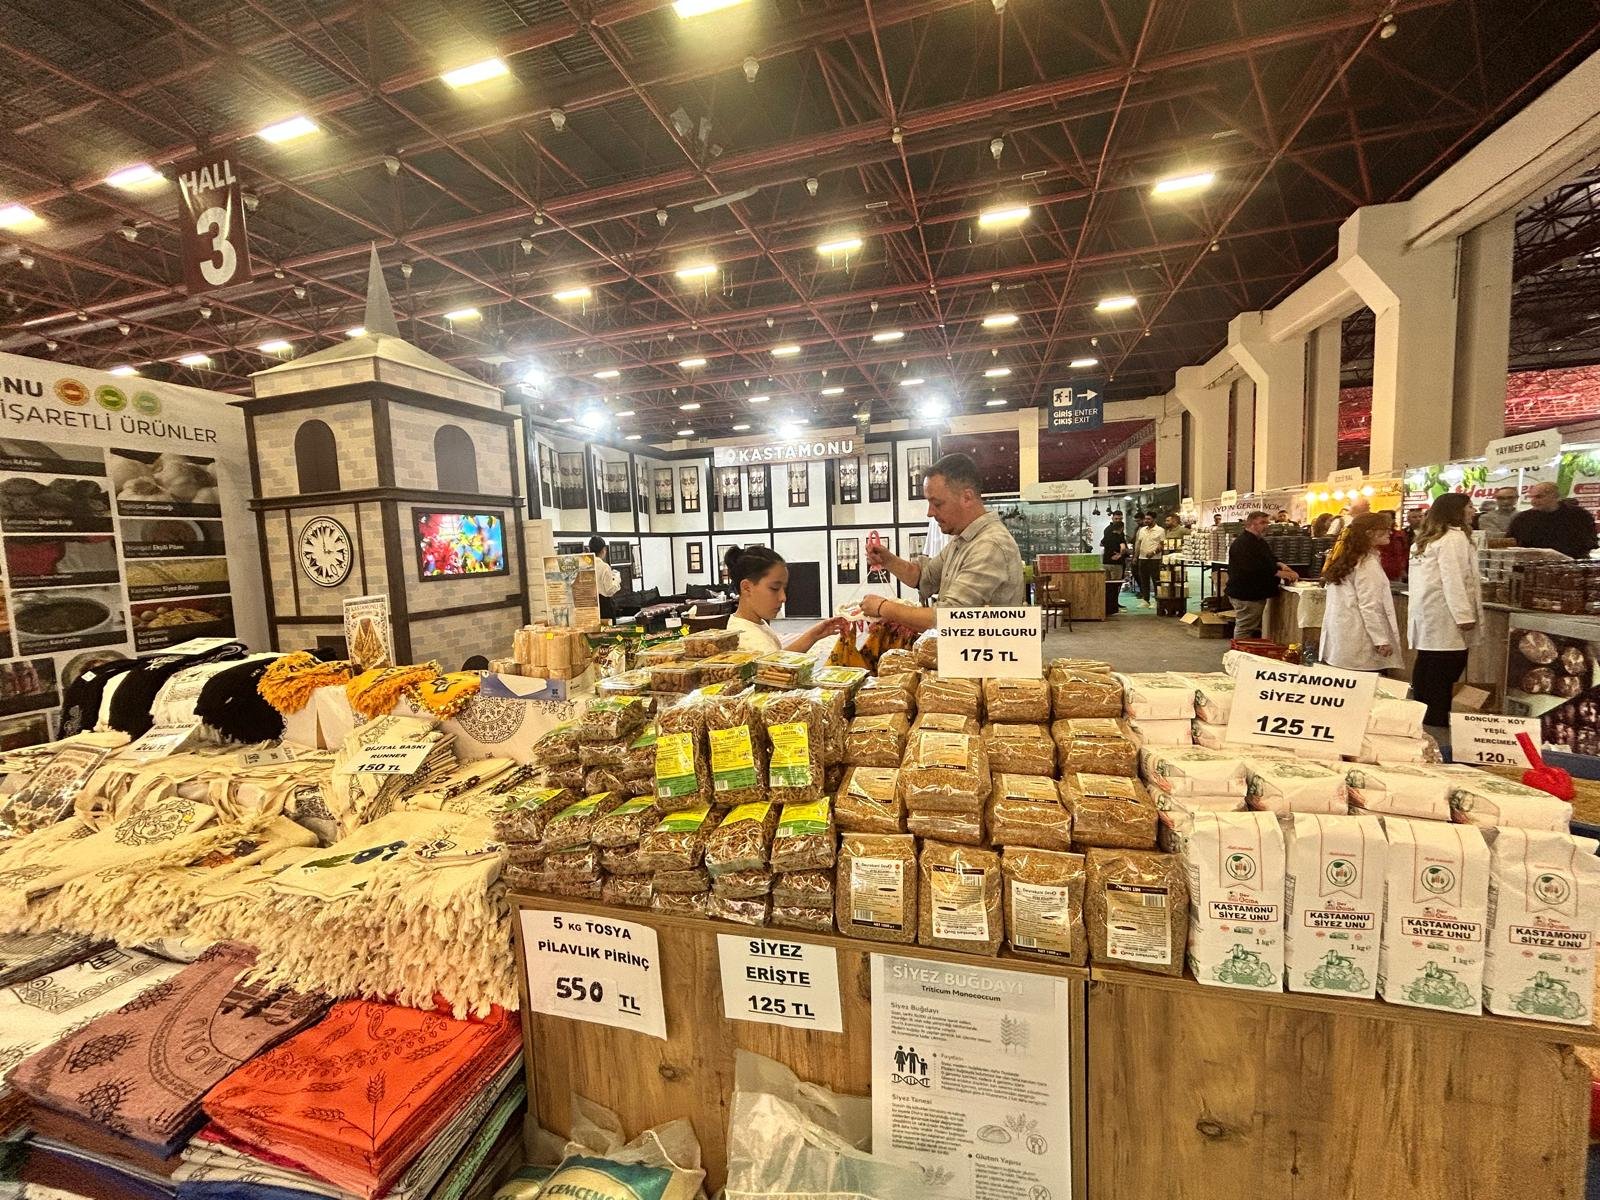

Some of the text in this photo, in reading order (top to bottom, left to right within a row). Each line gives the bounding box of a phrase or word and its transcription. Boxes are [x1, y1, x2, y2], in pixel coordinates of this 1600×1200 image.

[182, 159, 236, 196] HALL
[196, 206, 237, 286] 3
[0, 375, 43, 397] NU
[1074, 408, 1098, 416] ENTER
[1053, 416, 1089, 426] ÇIKIŞ EXIT
[120, 415, 217, 443] ÜRÜNLER
[740, 440, 853, 461] KASTAMONU
[1495, 439, 1546, 456] YAYMER GIDA
[950, 610, 1026, 619] KASTAMONU
[940, 627, 1037, 637] SİYEZ BULGURU
[960, 648, 1018, 662] 175 TL
[1255, 670, 1357, 689] KASTAMONU
[1259, 689, 1345, 708] SİYEZ UNU
[1464, 715, 1500, 723] BONCUK
[1256, 715, 1335, 739] 125 TL
[1483, 727, 1507, 735] YEŞİL
[1475, 751, 1505, 763] 120
[358, 763, 386, 772] 150
[1213, 903, 1274, 913] KASTAMONU
[1219, 911, 1247, 920] SİYEZ
[1310, 912, 1370, 921] KASTAMONU
[553, 916, 632, 940] 5 KG TOSYA
[1407, 919, 1476, 931] KASTAMONU
[1413, 927, 1471, 939] SİYEZ UNU
[1516, 928, 1587, 940] KASTAMONU
[749, 939, 803, 958] SİYEZ
[1521, 936, 1582, 948] SİYEZ UNU
[538, 939, 650, 971] PİLAVLIK PİRİNÇ
[746, 966, 811, 985] ERİŞTE
[893, 963, 1025, 995] SİYEZ BUĞDAYI
[556, 976, 641, 1010] 550 TL
[921, 985, 1001, 1002] Triticum Monococcum
[748, 995, 815, 1017] 125 TL
[891, 1002, 939, 1014] Siyez Buğdayı
[891, 1093, 932, 1104] Siyez Tanesi
[975, 1153, 999, 1162] Gluten
